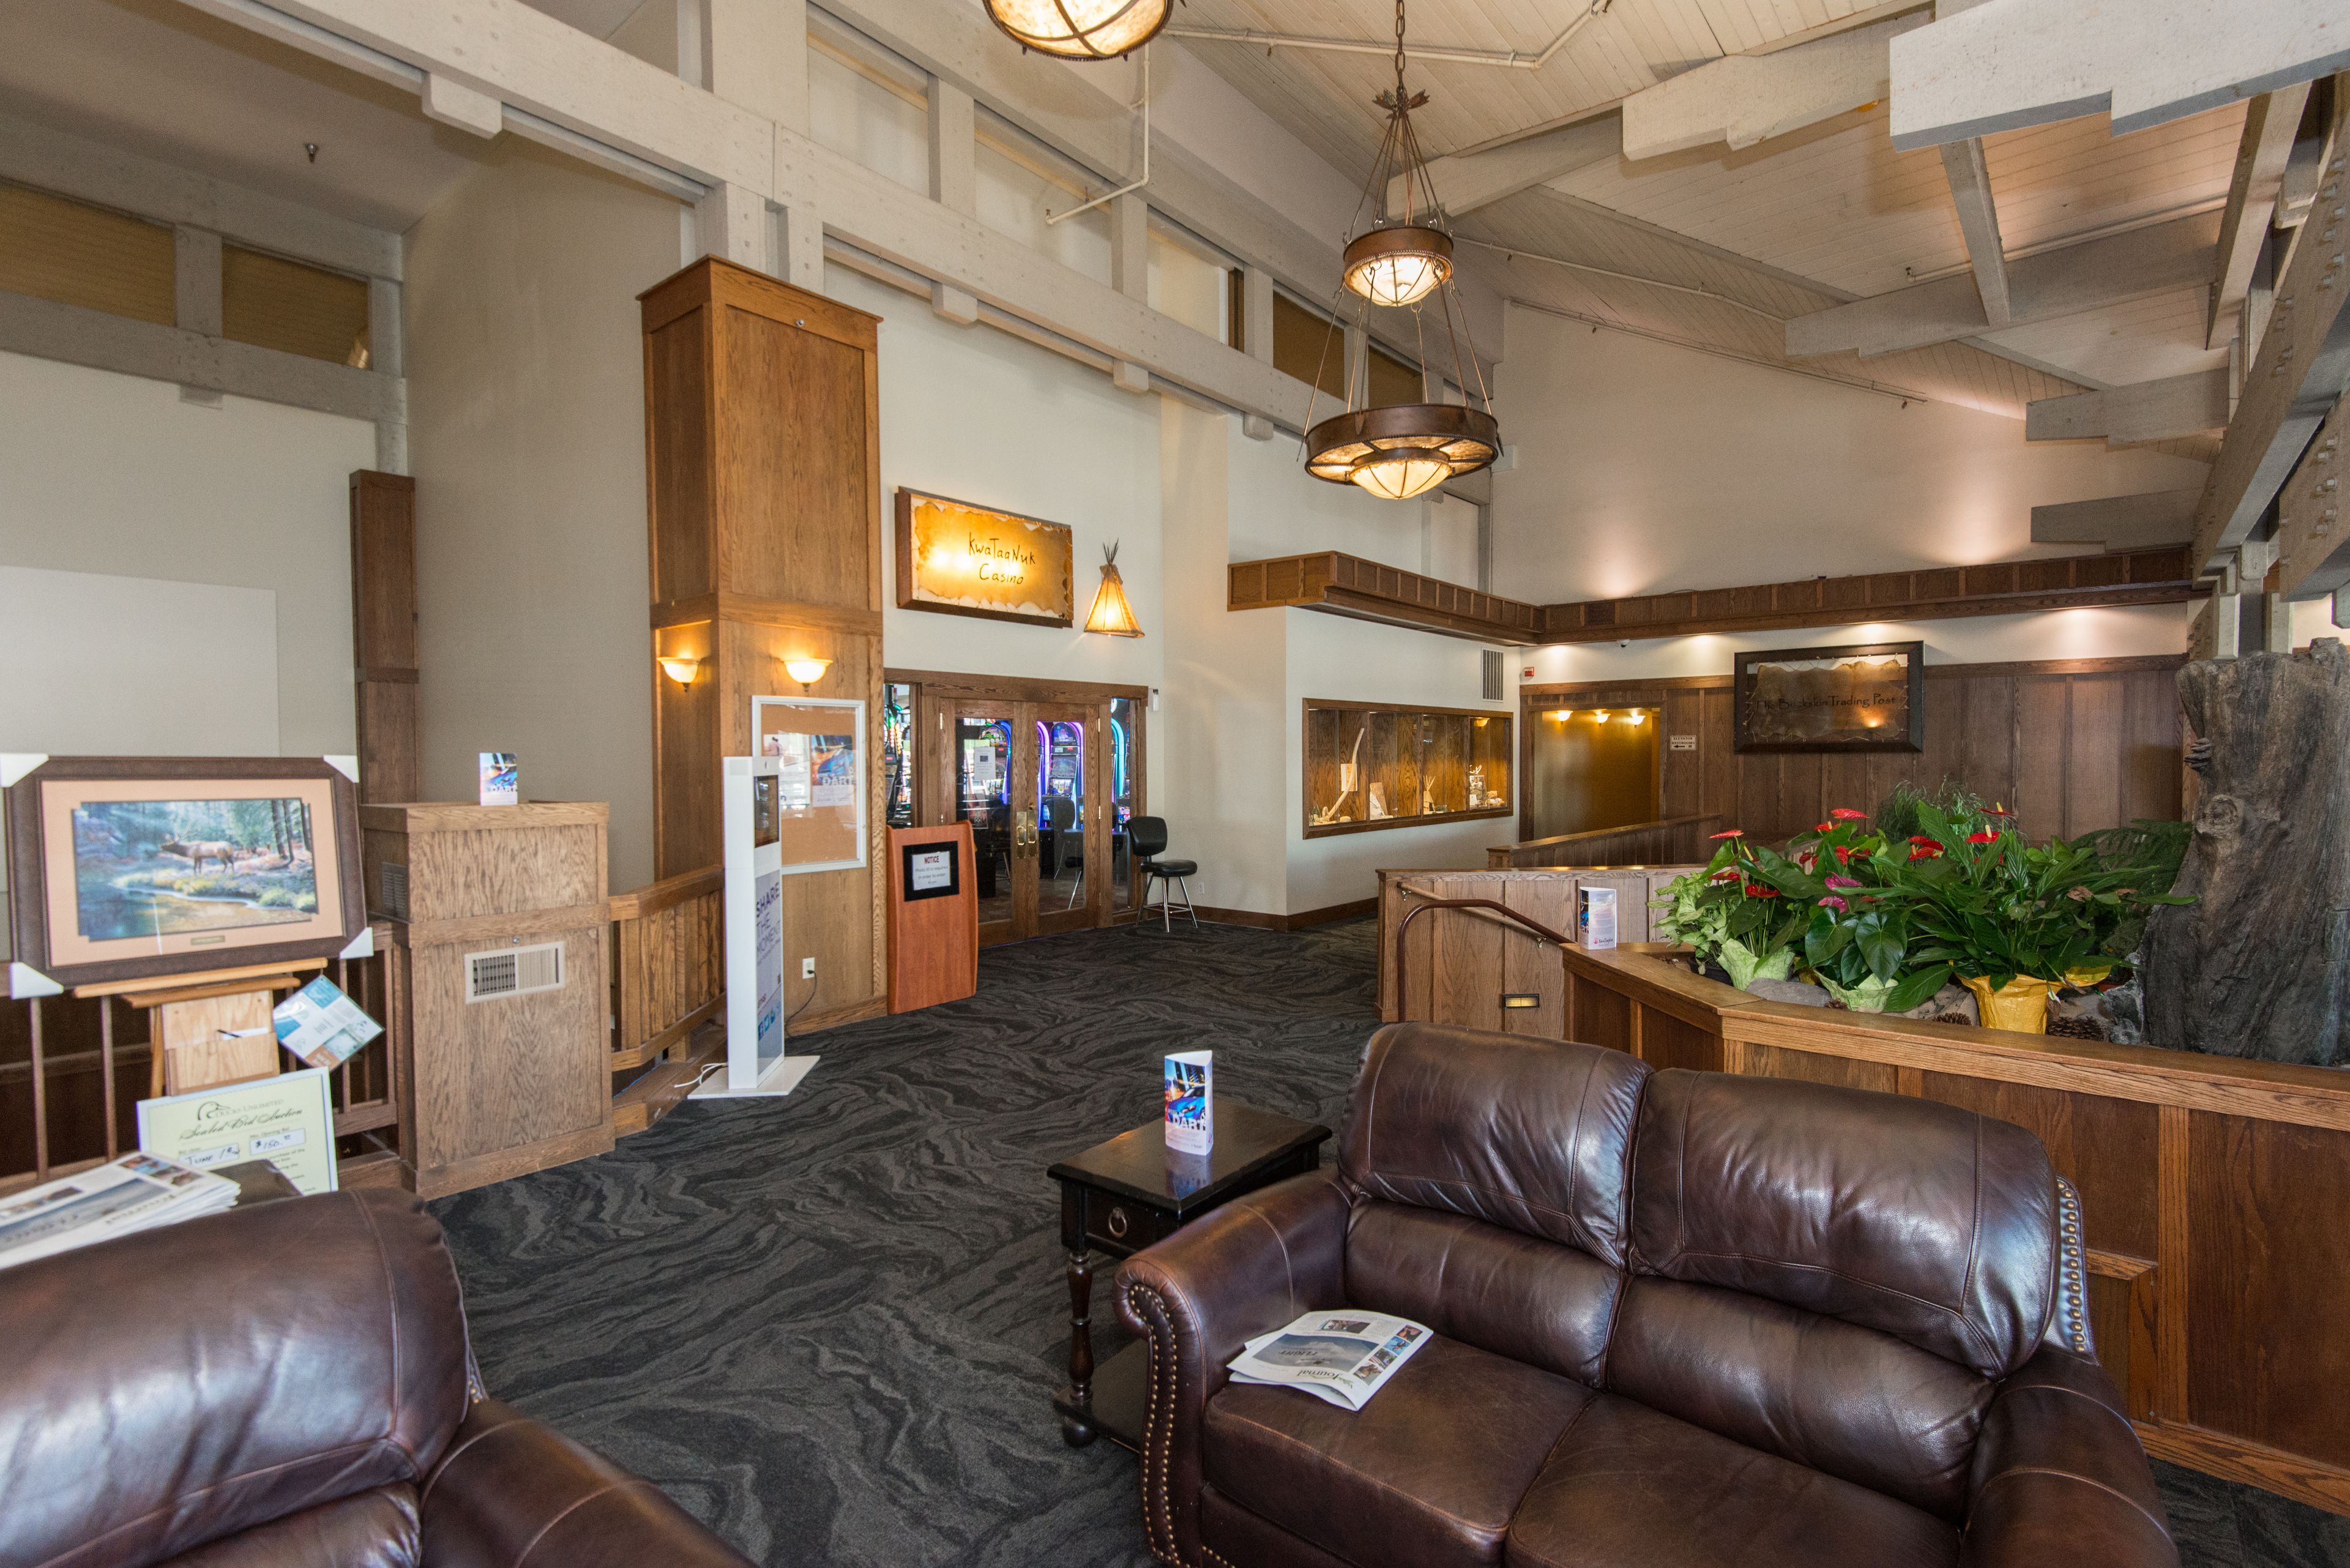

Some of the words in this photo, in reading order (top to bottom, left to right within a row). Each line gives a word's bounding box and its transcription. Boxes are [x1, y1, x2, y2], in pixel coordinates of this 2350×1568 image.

[979, 563, 1024, 584] Casino
[1754, 699, 1776, 711] The
[1827, 695, 1870, 707] Trading
[1873, 693, 1897, 705] Post
[756, 883, 780, 918] SHARE
[756, 913, 770, 938] THE
[179, 1121, 228, 1140] Sealed
[228, 1114, 258, 1129] Bid
[257, 1108, 302, 1124] Auction
[1297, 1370, 1343, 1380] Journal
